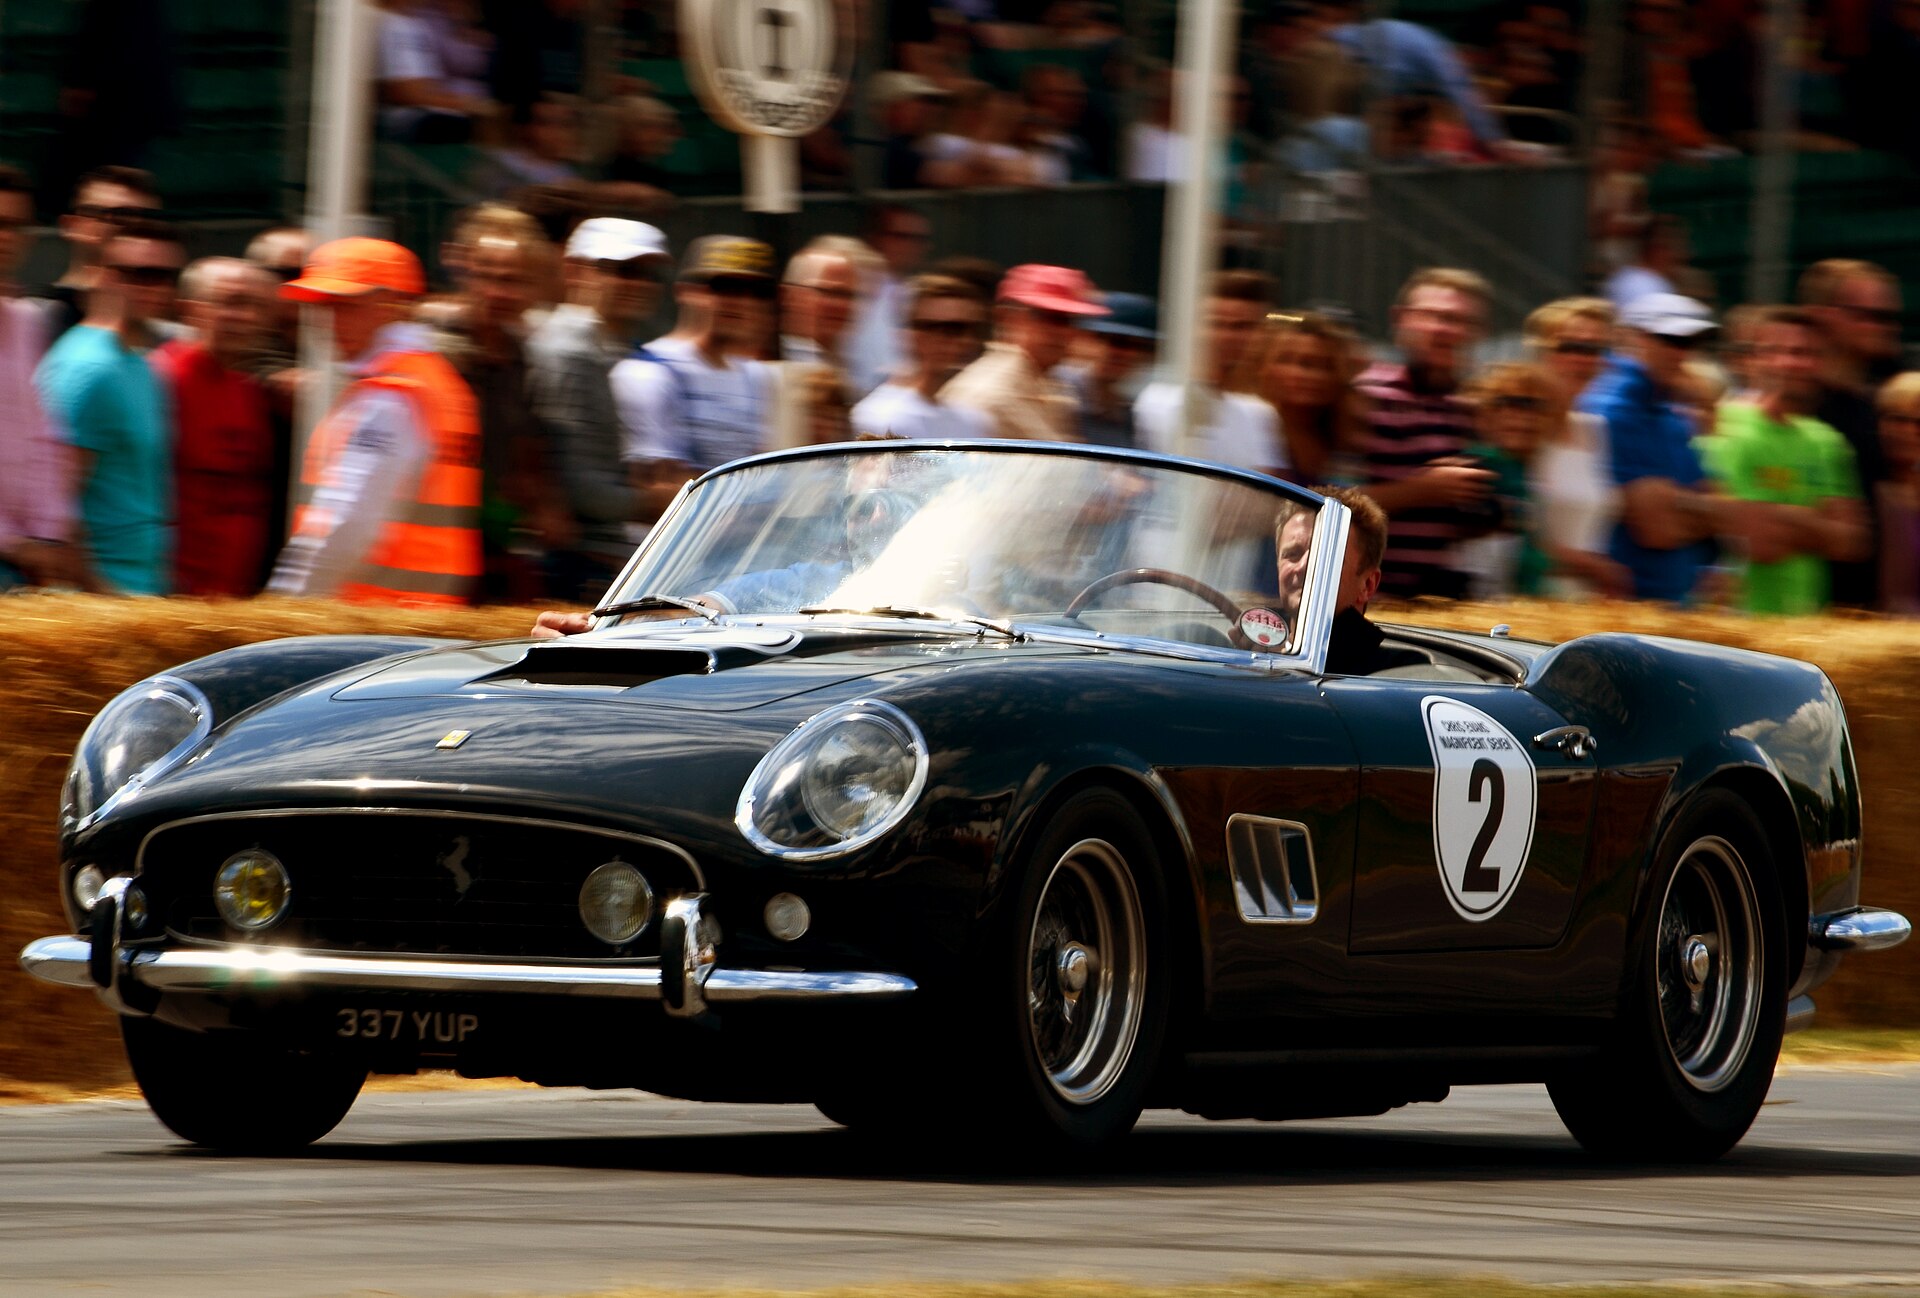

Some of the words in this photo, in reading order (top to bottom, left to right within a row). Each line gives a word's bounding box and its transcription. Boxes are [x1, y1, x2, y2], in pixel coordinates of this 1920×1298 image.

[1487, 736, 1513, 751] SEVEN
[1462, 757, 1505, 892] 2
[336, 1008, 404, 1041] 337
[411, 1010, 479, 1042] YUP
